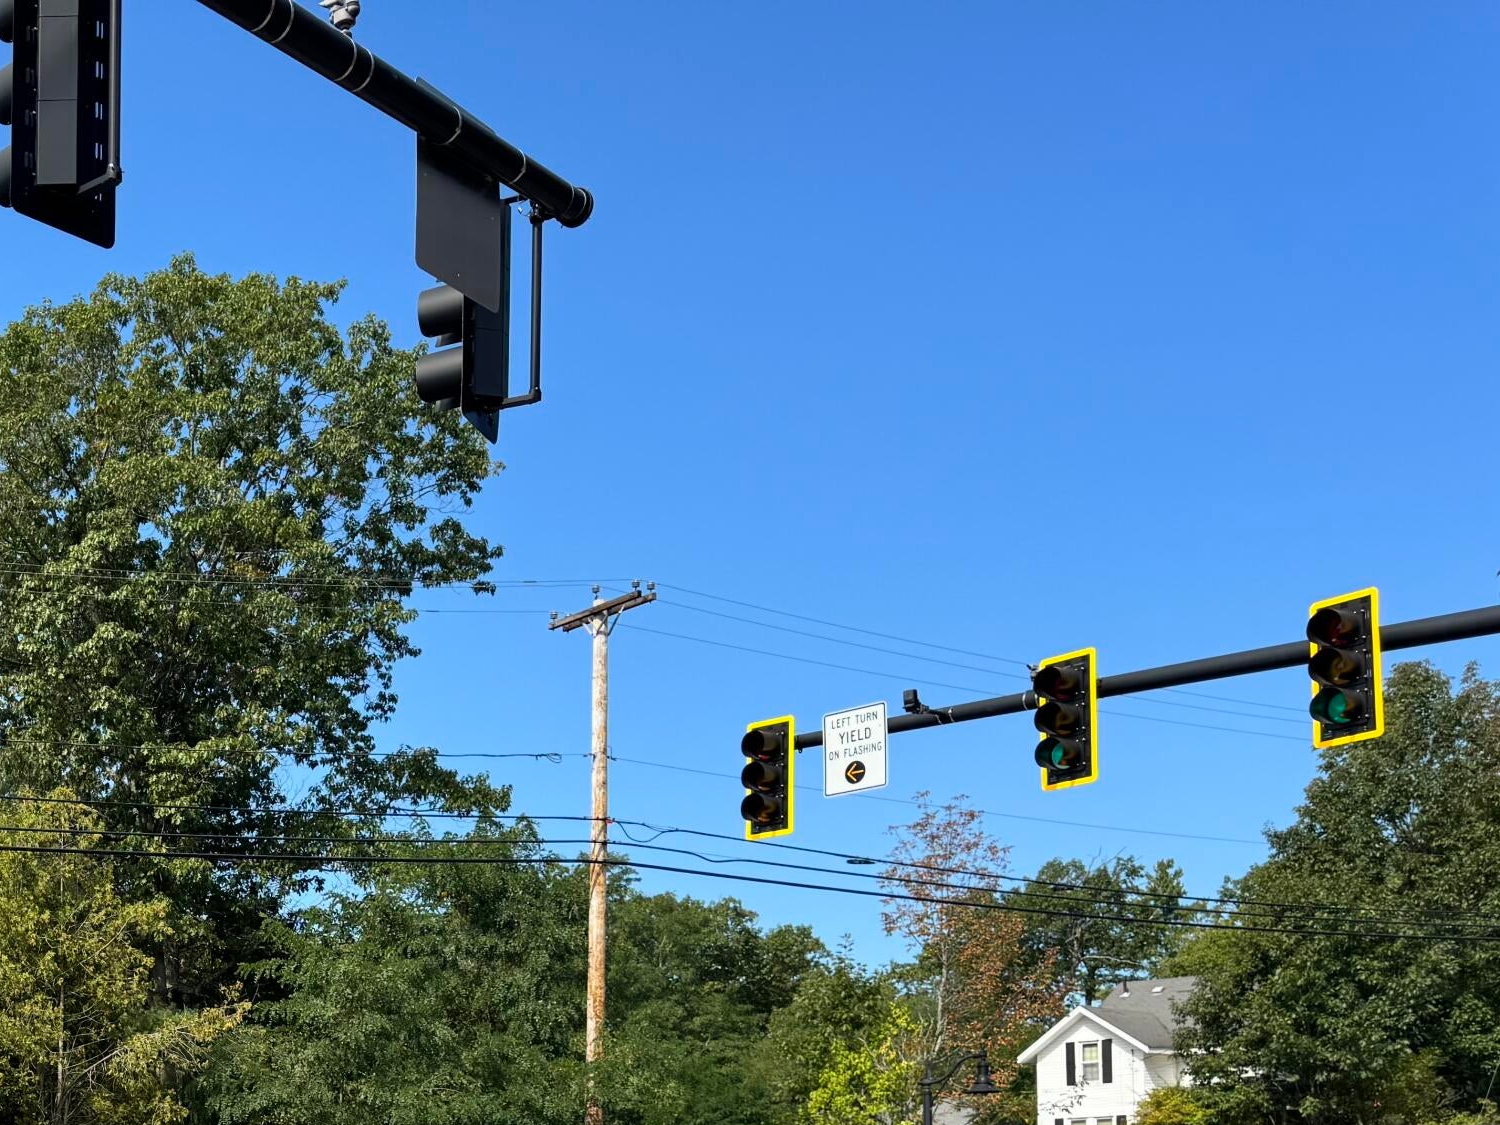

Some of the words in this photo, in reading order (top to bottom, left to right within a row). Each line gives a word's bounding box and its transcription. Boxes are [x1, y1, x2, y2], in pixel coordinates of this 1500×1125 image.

[831, 716, 851, 730] LEFT
[855, 711, 878, 725] TURN
[839, 727, 872, 745] YIELD
[828, 751, 840, 761] ON
[843, 741, 883, 758] FLASHING
